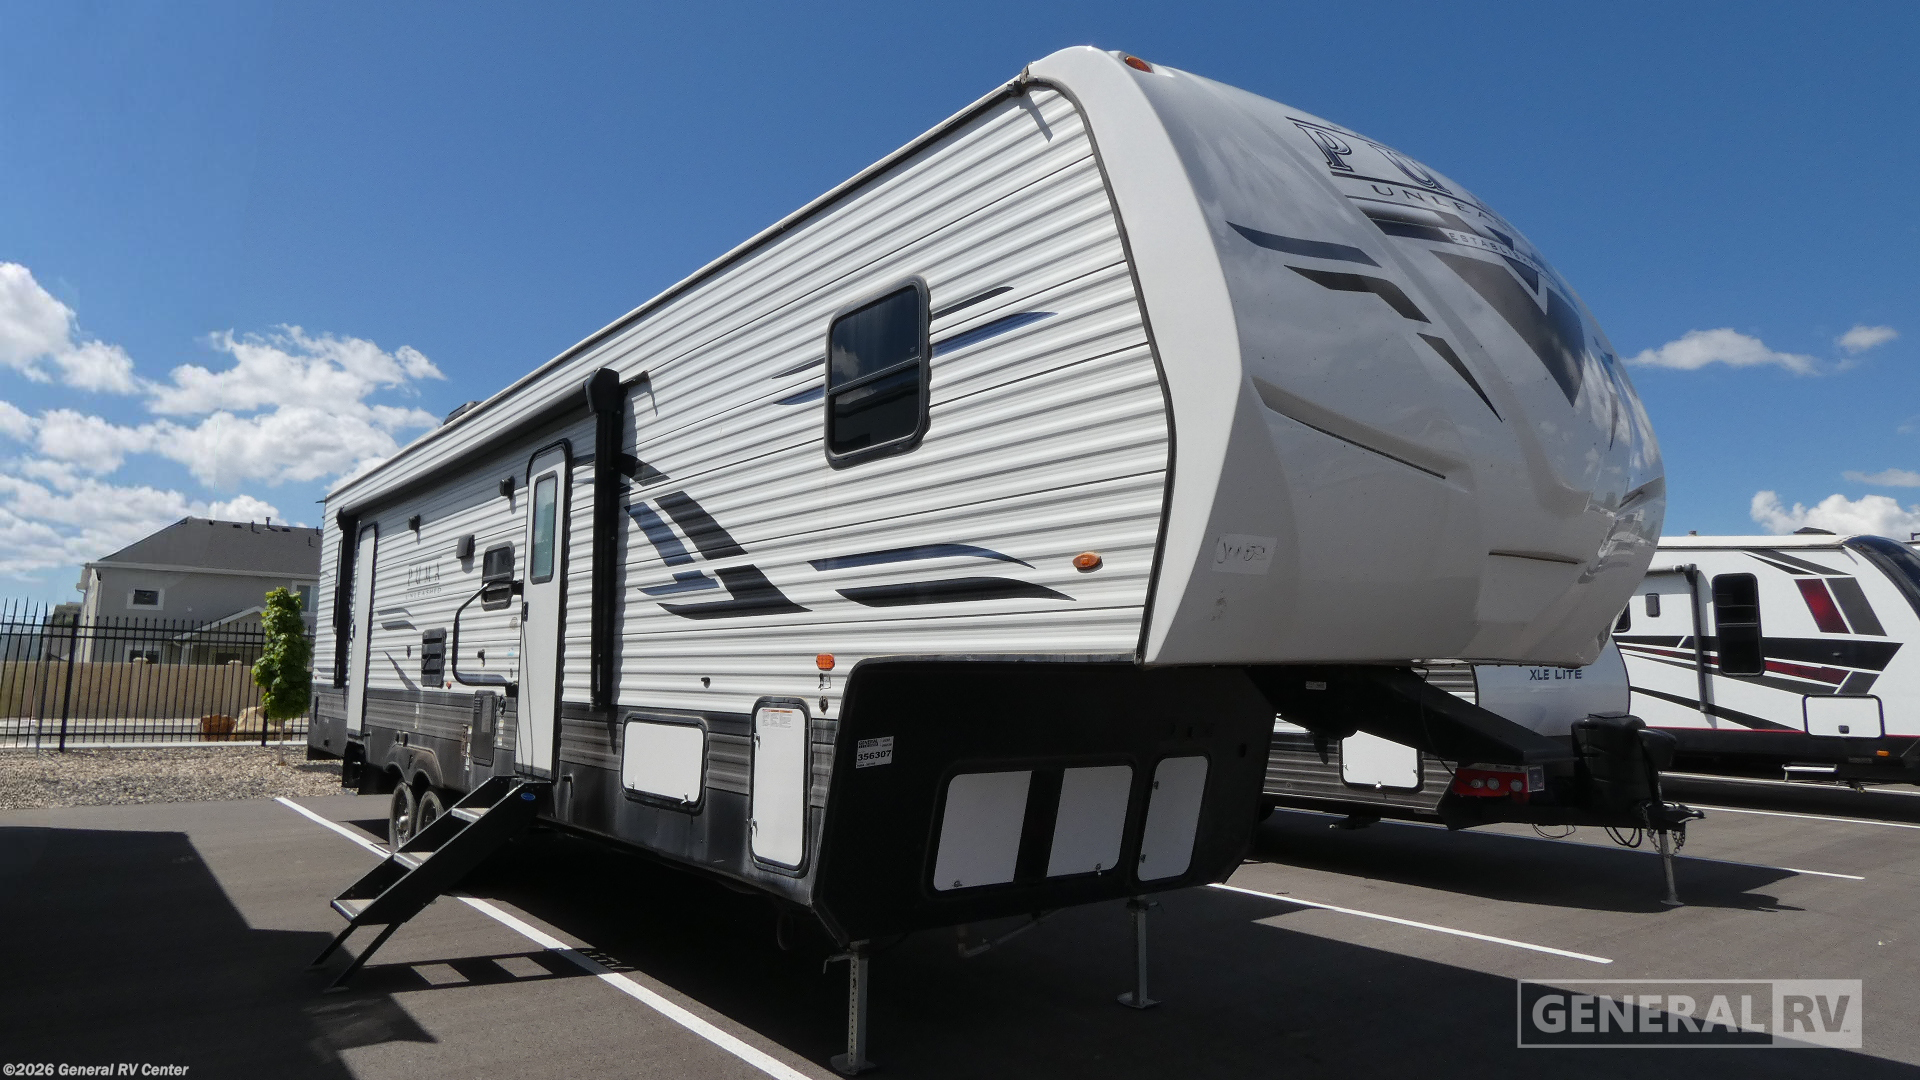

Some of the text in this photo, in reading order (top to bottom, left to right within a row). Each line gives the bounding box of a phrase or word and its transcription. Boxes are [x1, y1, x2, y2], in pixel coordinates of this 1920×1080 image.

[1293, 121, 1454, 196] PU
[407, 562, 441, 587] PUMA
[1529, 669, 1583, 680] XLE LITE
[857, 749, 892, 761] 356307
